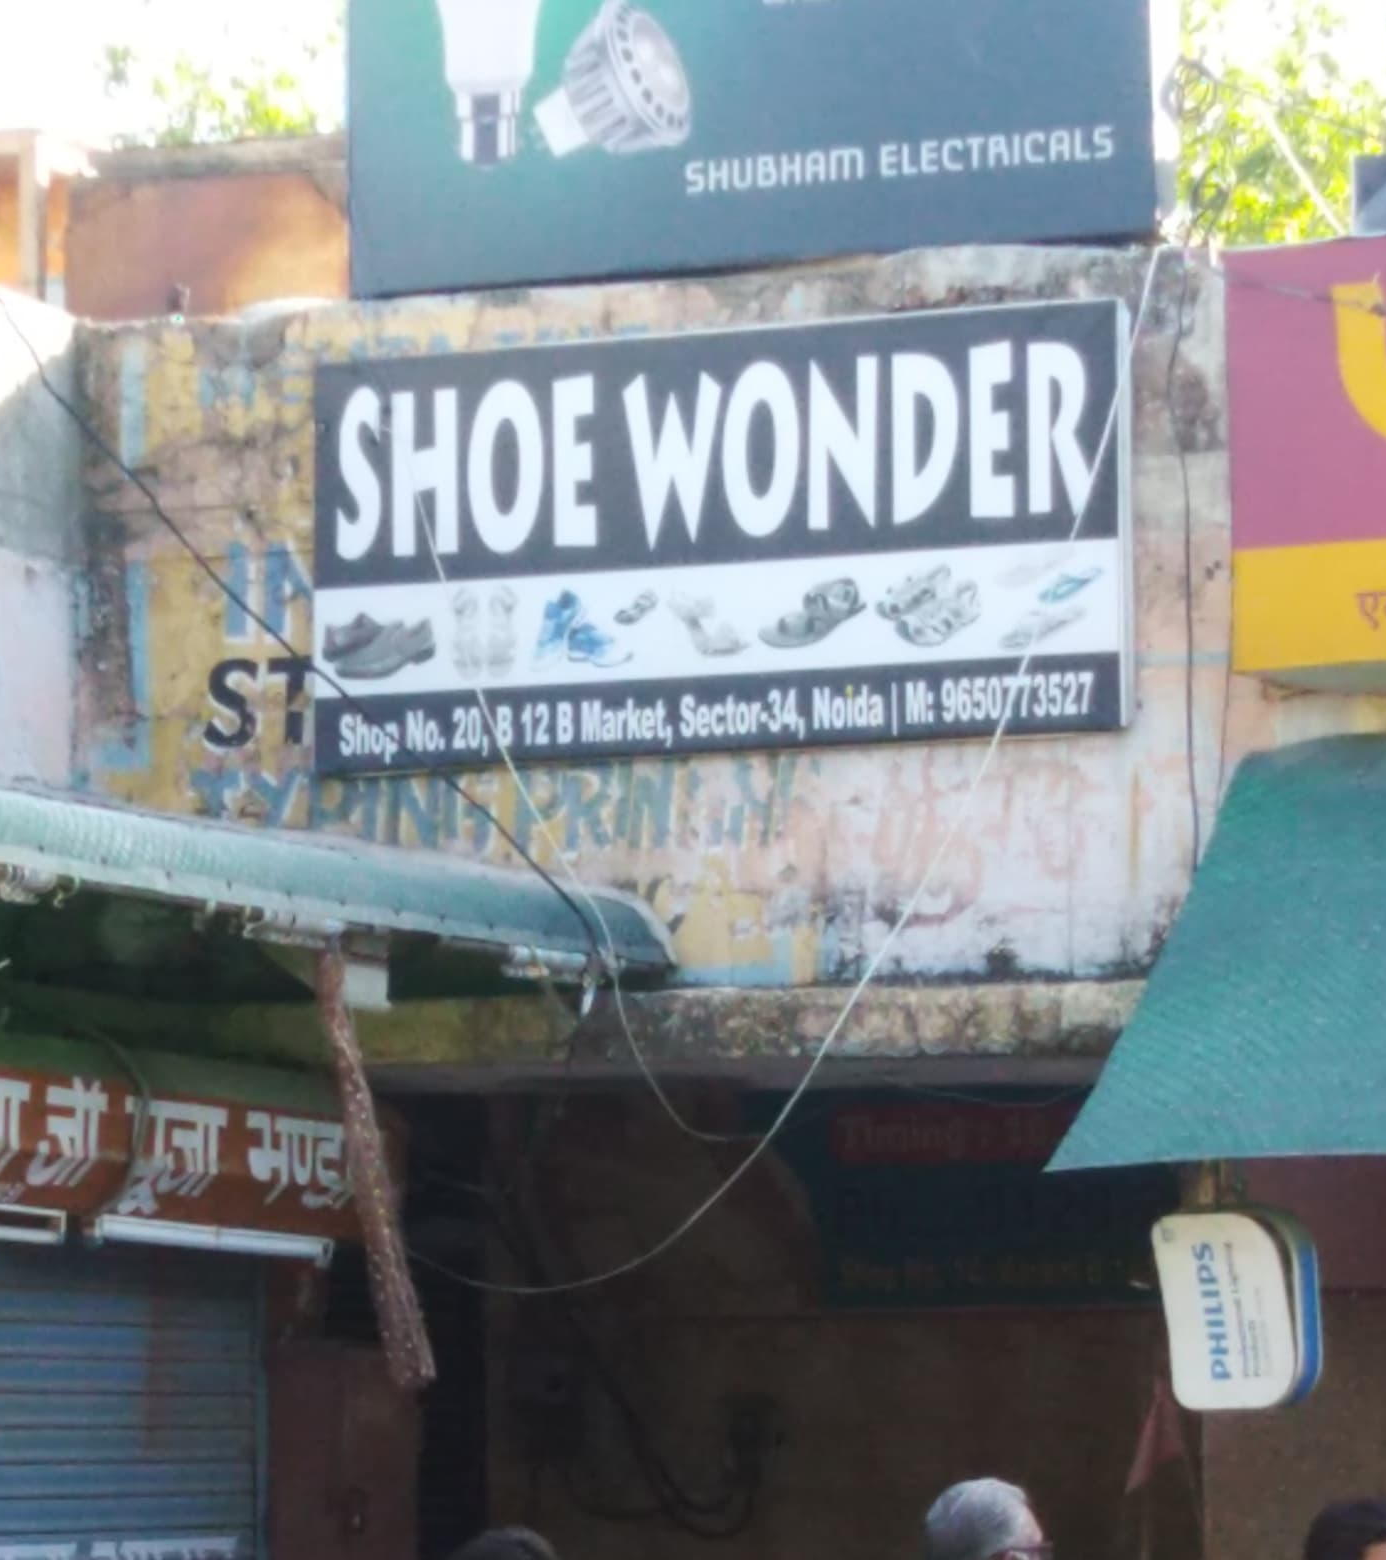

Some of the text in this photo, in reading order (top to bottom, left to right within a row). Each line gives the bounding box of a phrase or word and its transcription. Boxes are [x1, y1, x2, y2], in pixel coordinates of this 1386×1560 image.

[684, 126, 1117, 196] SHUBHAM ELECTRICALS
[334, 340, 1101, 562] SHOE WONDER
[339, 712, 399, 764] Shop
[405, 711, 447, 753] No.
[453, 707, 489, 757] 20,
[495, 706, 515, 746] B
[521, 704, 550, 745] 12
[556, 703, 575, 744] B
[581, 698, 674, 748] Market,
[679, 689, 807, 741] Sector-34,
[813, 684, 884, 730] Noida
[905, 683, 936, 724] M:
[942, 671, 1094, 723] 9650773527
[1190, 1240, 1233, 1383] PHILIPS
